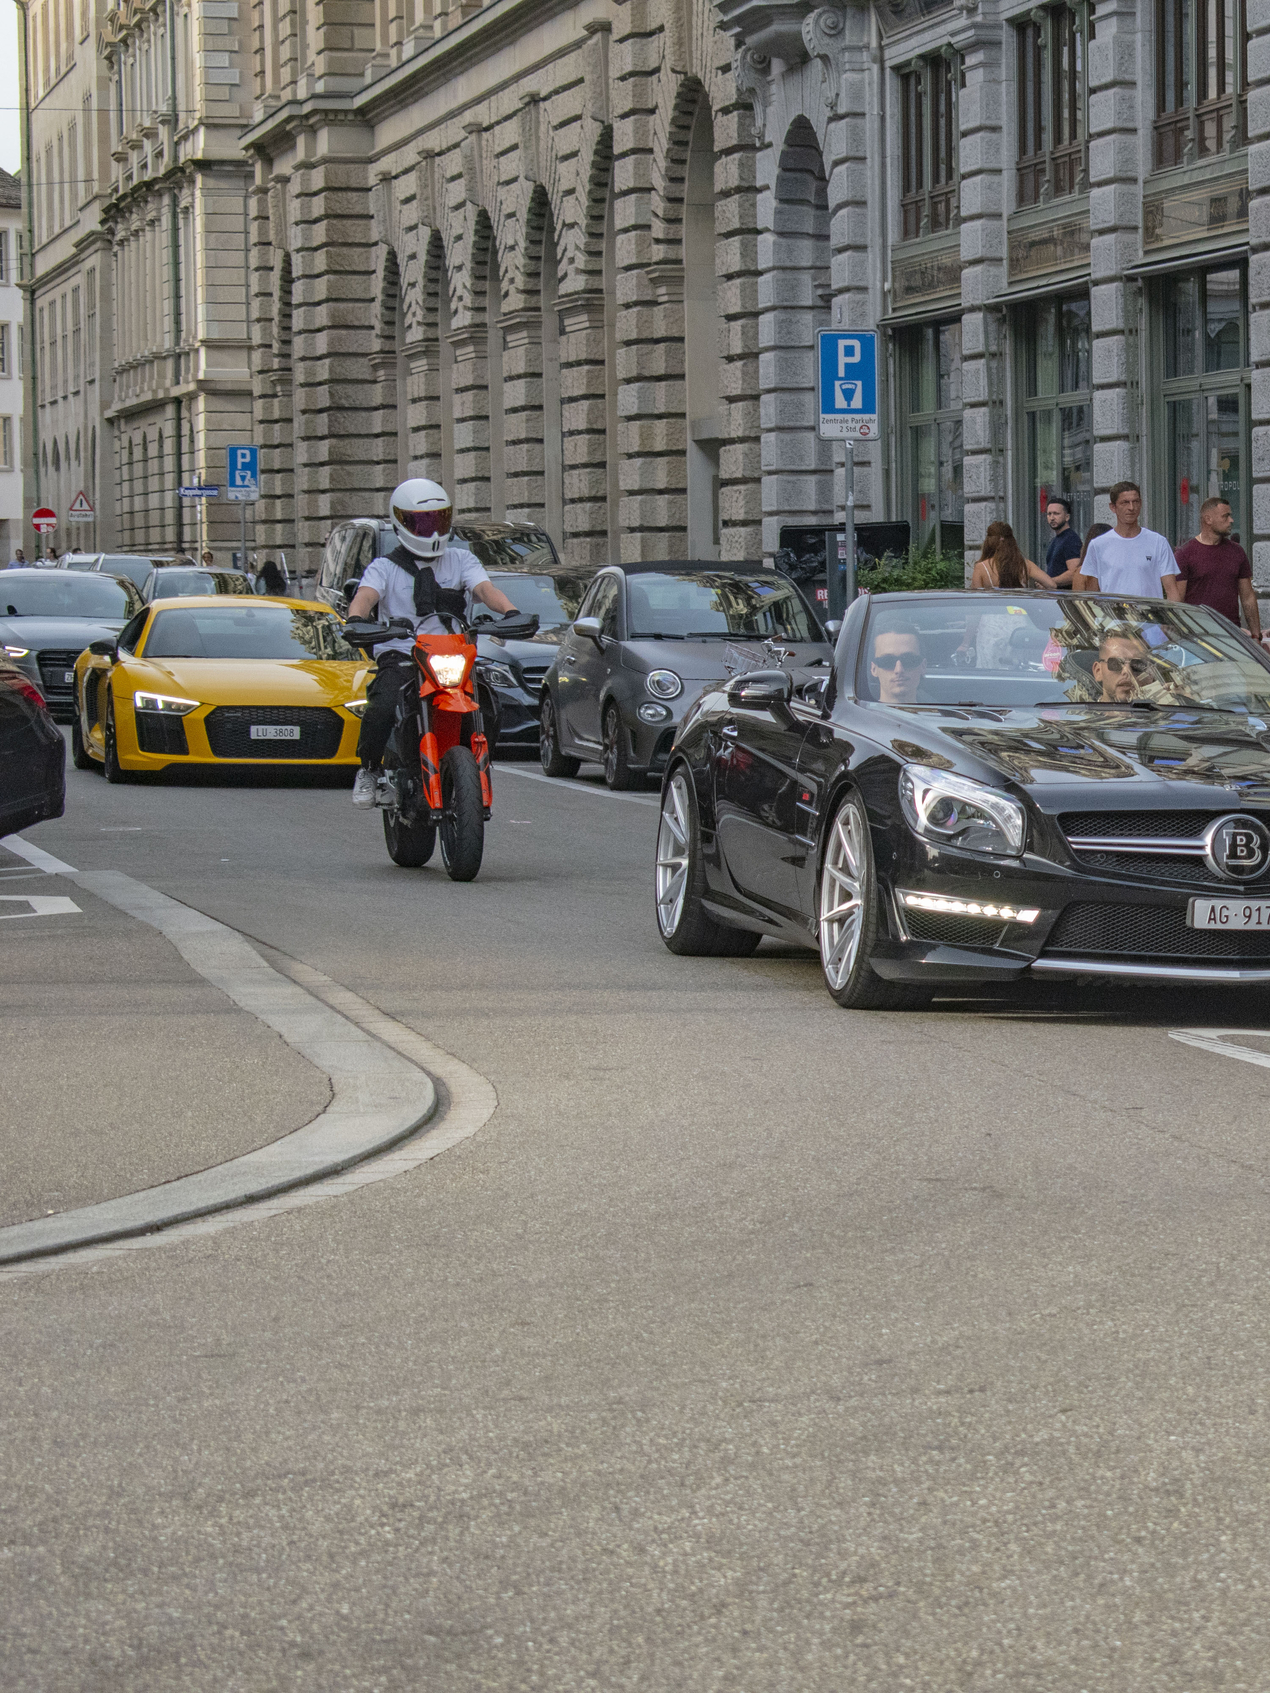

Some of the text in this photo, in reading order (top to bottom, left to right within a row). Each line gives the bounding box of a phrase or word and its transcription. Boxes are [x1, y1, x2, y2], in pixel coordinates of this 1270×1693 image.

[838, 338, 861, 377] P
[821, 416, 876, 425] Zentrale Parkuhr
[839, 425, 844, 433] 2
[237, 449, 251, 469] P
[1223, 829, 1263, 865] B
